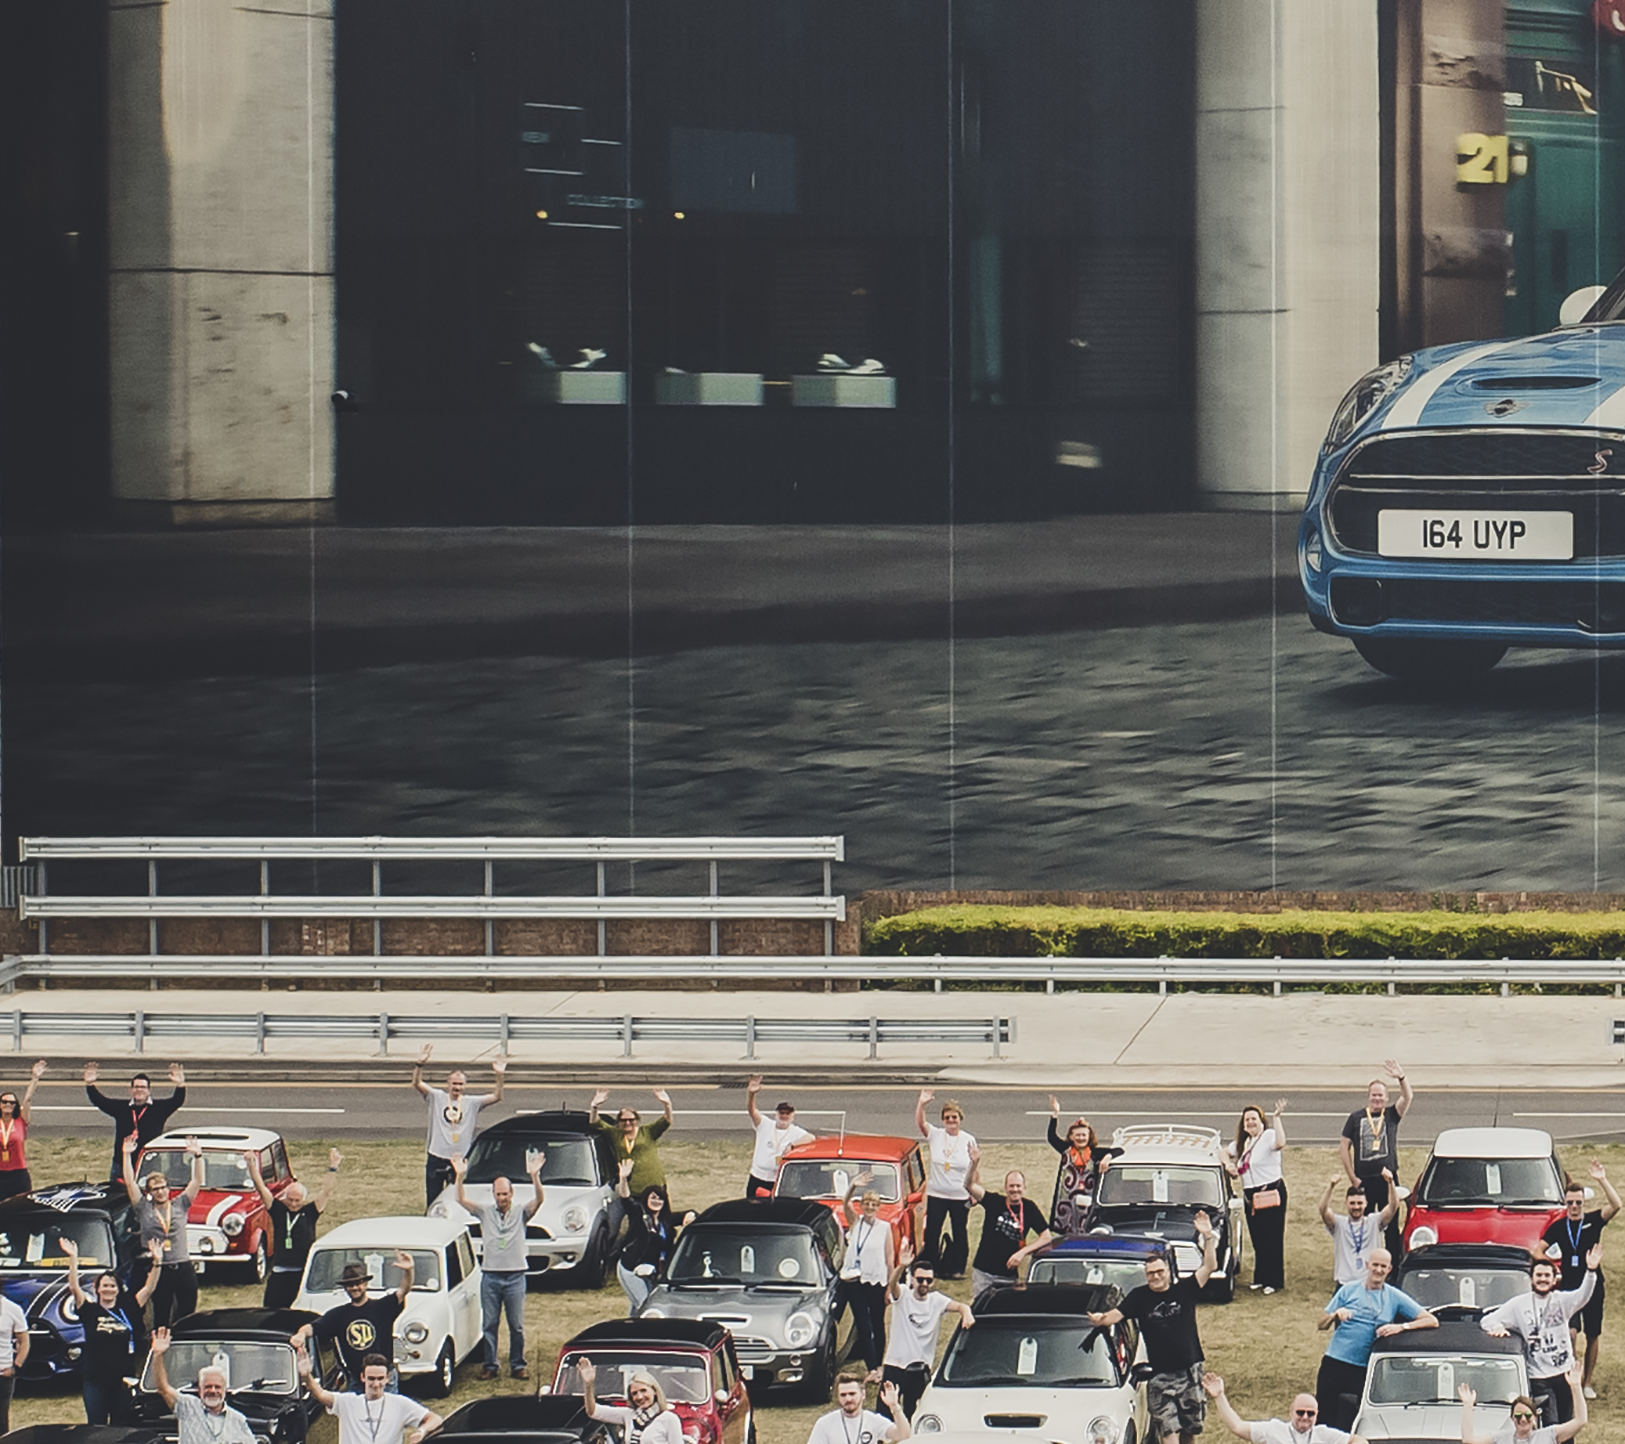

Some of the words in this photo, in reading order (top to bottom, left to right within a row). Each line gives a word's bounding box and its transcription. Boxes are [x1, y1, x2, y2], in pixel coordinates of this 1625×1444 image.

[1456, 132, 1509, 184] 21
[1422, 519, 1463, 548] 164
[1473, 520, 1526, 549] UYP
